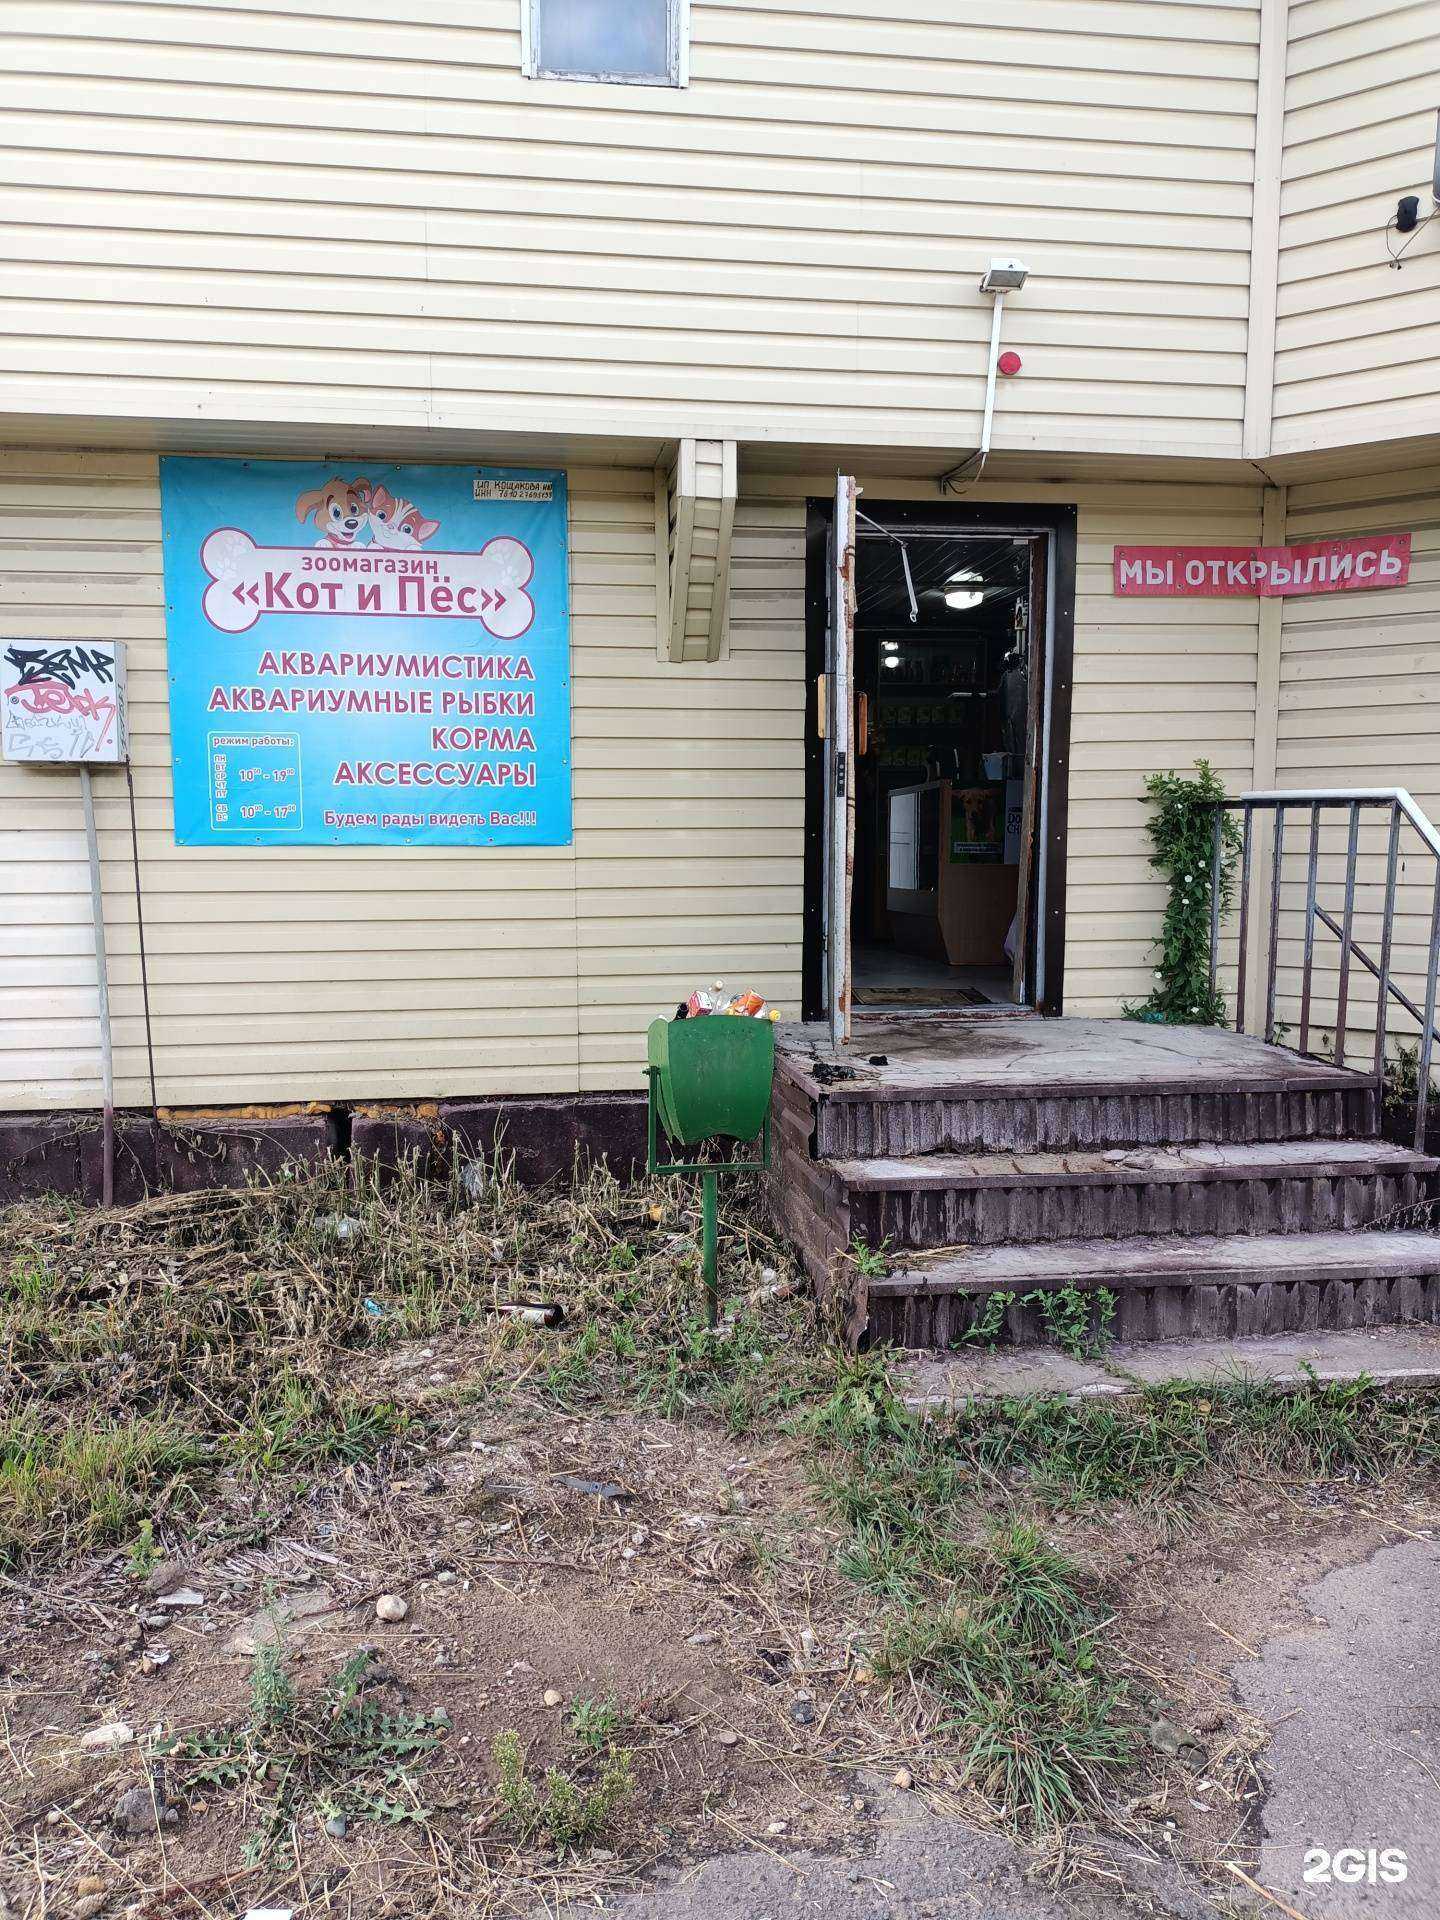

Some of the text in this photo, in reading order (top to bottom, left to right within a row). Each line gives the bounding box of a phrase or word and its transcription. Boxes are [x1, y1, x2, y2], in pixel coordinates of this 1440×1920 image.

[475, 488, 491, 497] ИНН
[302, 556, 438, 575] зоомагазин
[1120, 549, 1402, 585] МЫ ОТКРЫЛИСЬ
[231, 571, 507, 613] «Кот и Пёс»
[258, 651, 535, 680] АКВАРИУМИСТИКА
[208, 687, 535, 715] АКВАРИУМНЫЕ РЫБКИ
[213, 735, 295, 747] режим работы:
[432, 727, 535, 750] КОРМА
[334, 762, 535, 786] АКСЕССУАРЫ
[324, 811, 536, 828] Будем рады видеть Вас!!!
